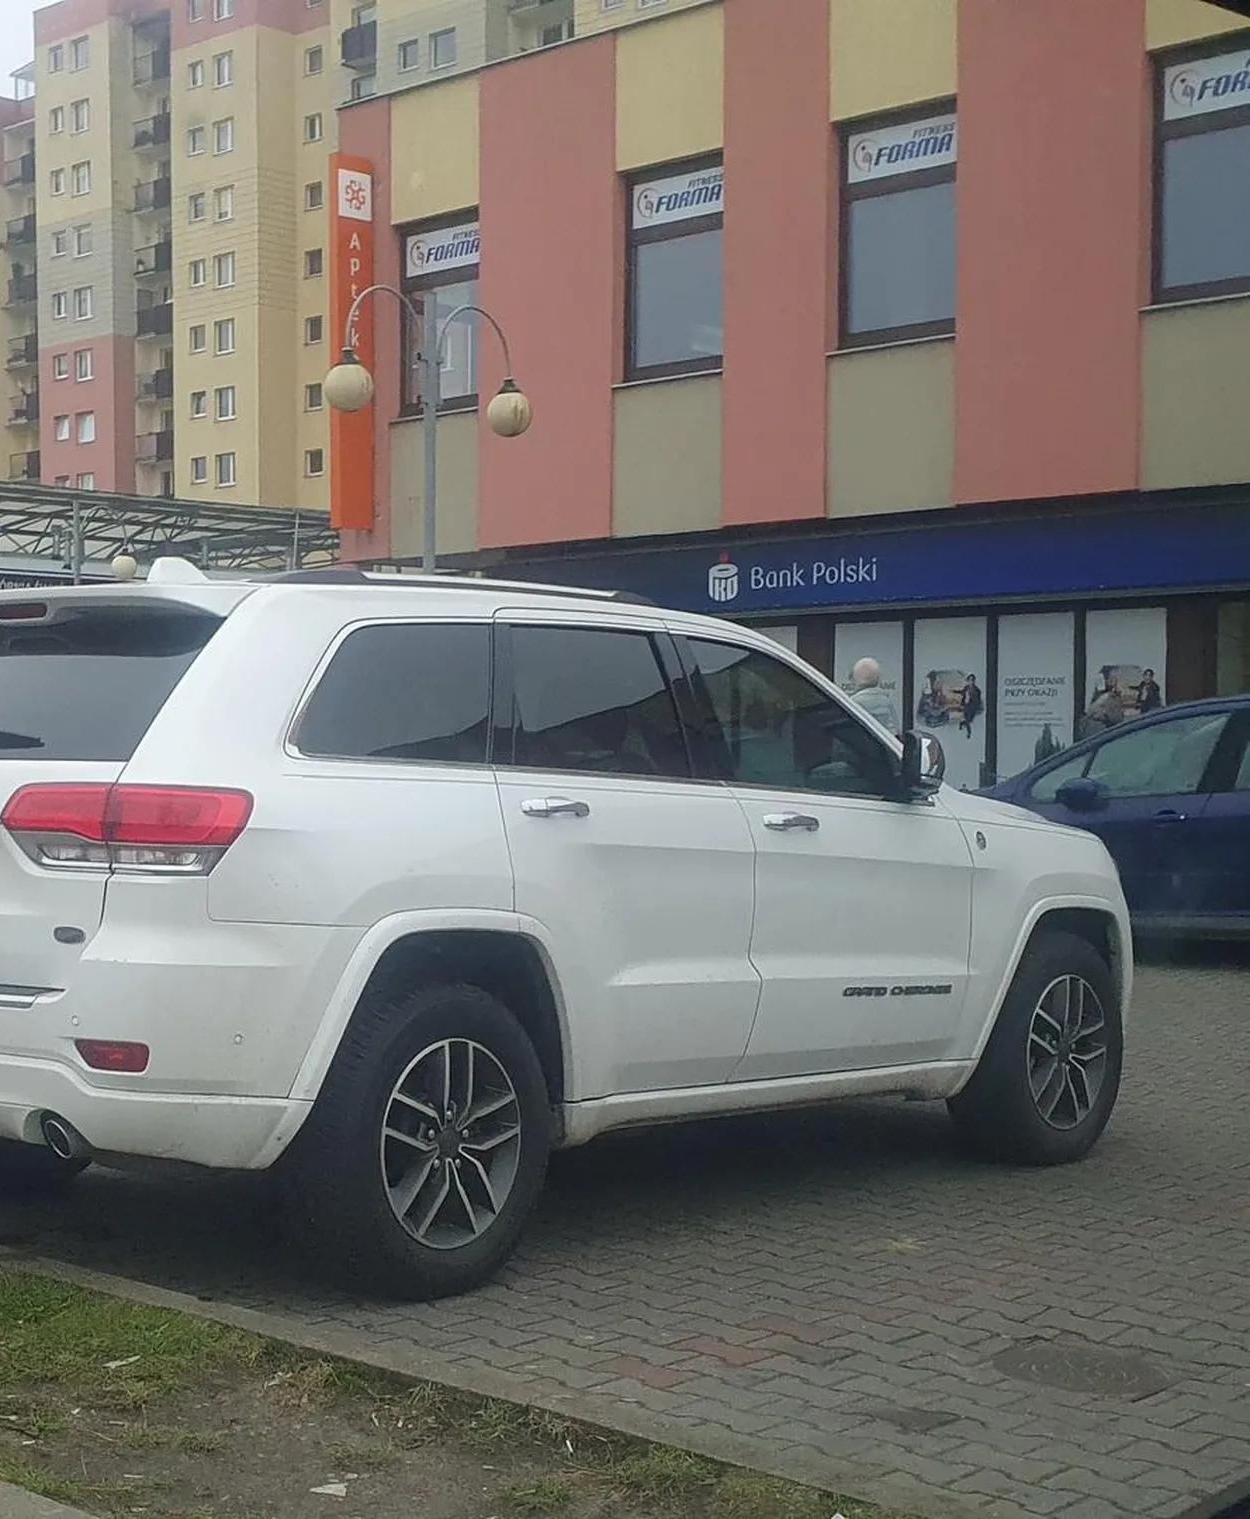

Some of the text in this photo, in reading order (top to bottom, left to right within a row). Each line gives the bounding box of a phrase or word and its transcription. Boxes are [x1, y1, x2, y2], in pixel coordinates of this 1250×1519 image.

[873, 133, 954, 167] FORMA
[654, 183, 723, 214] FORMA
[425, 238, 480, 264] FORMA
[750, 562, 805, 590] Bank
[812, 556, 878, 585] Polski
